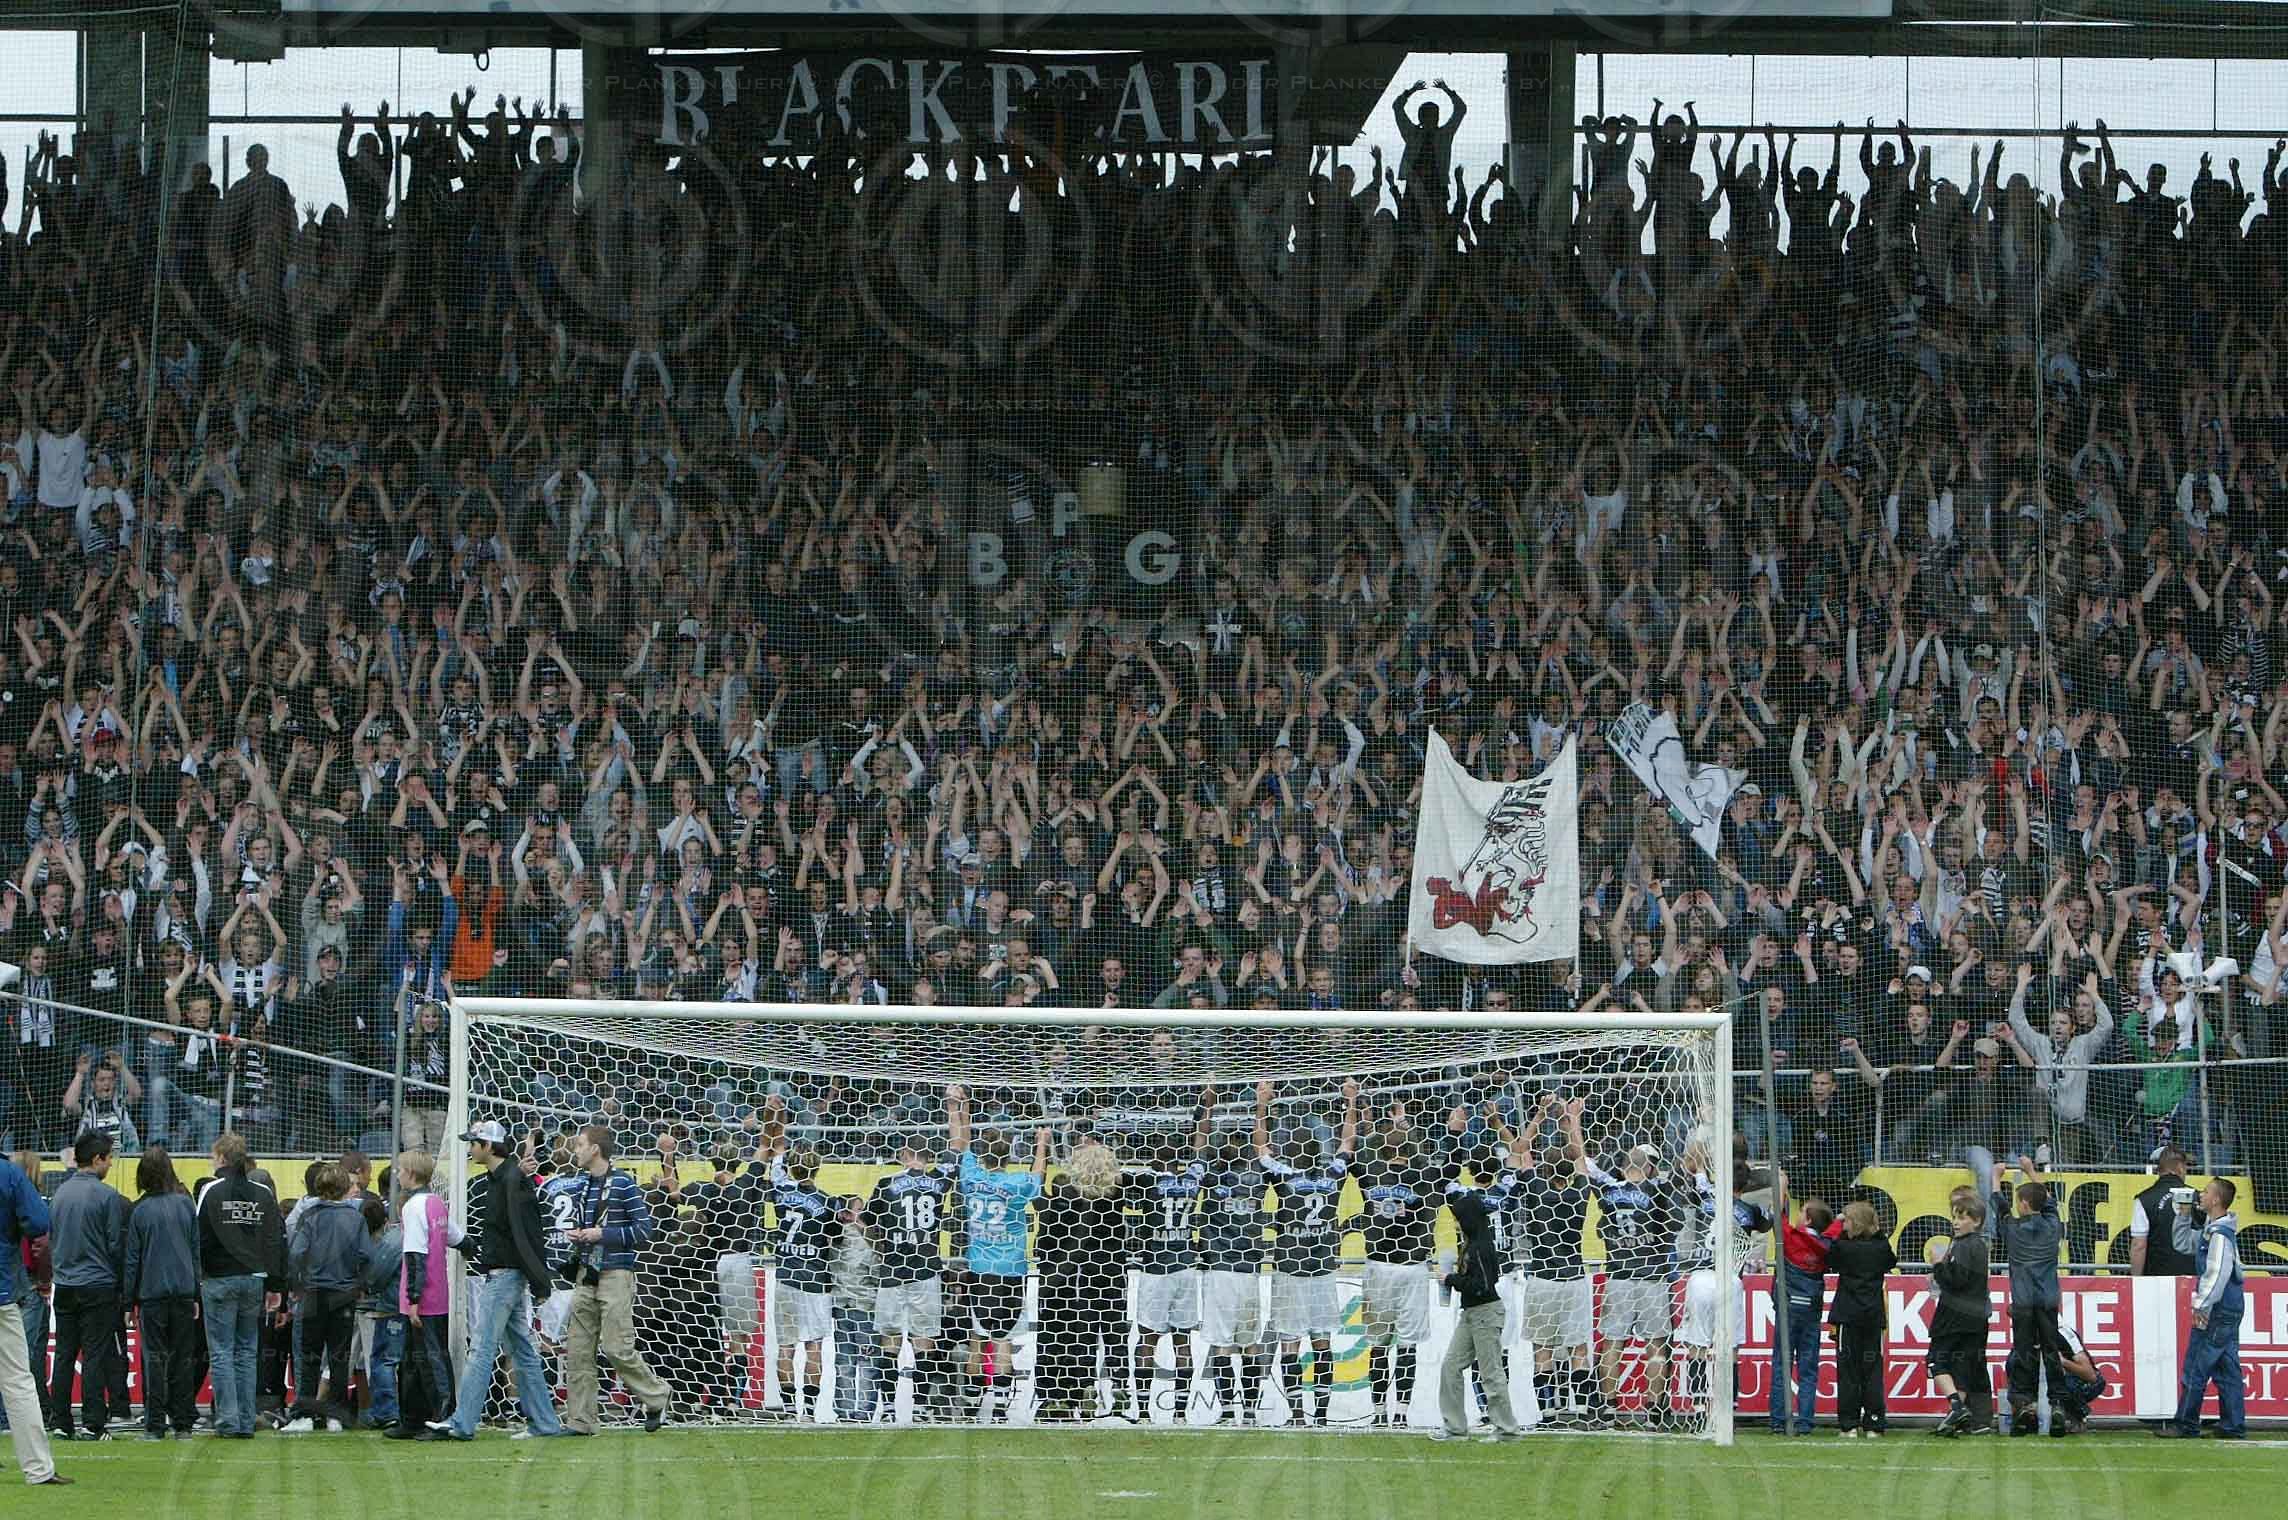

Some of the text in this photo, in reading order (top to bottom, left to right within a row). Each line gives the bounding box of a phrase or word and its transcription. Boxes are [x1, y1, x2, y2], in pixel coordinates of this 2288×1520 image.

[967, 533, 1009, 585] B
[1125, 531, 1183, 585] G
[785, 1210, 804, 1242] 7
[901, 1195, 936, 1230] 18
[968, 1197, 1008, 1231] 22
[1162, 1197, 1193, 1230] 17
[1304, 1195, 1324, 1226] 2
